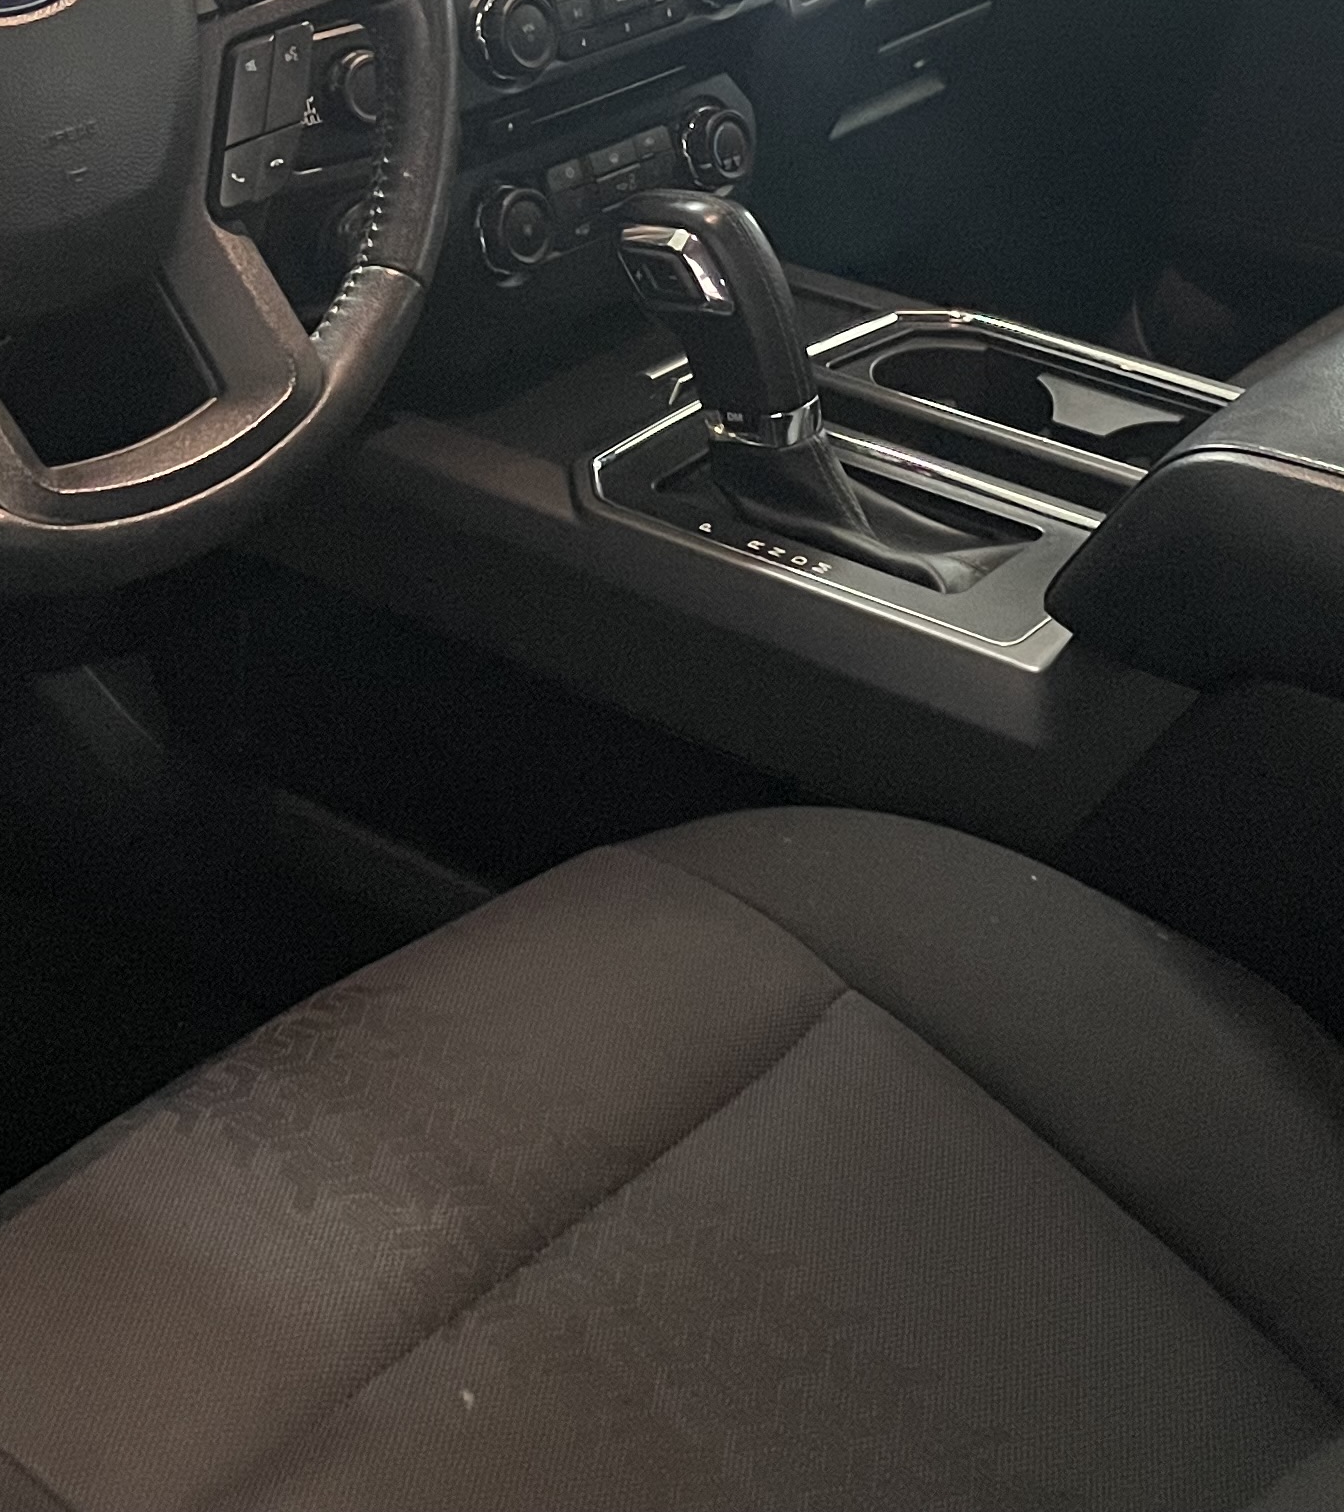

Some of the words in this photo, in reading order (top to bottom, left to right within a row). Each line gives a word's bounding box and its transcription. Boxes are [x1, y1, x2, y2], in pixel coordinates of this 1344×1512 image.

[698, 521, 713, 534] P
[746, 539, 766, 551] R
[790, 555, 809, 567] D
[811, 561, 833, 575] M
